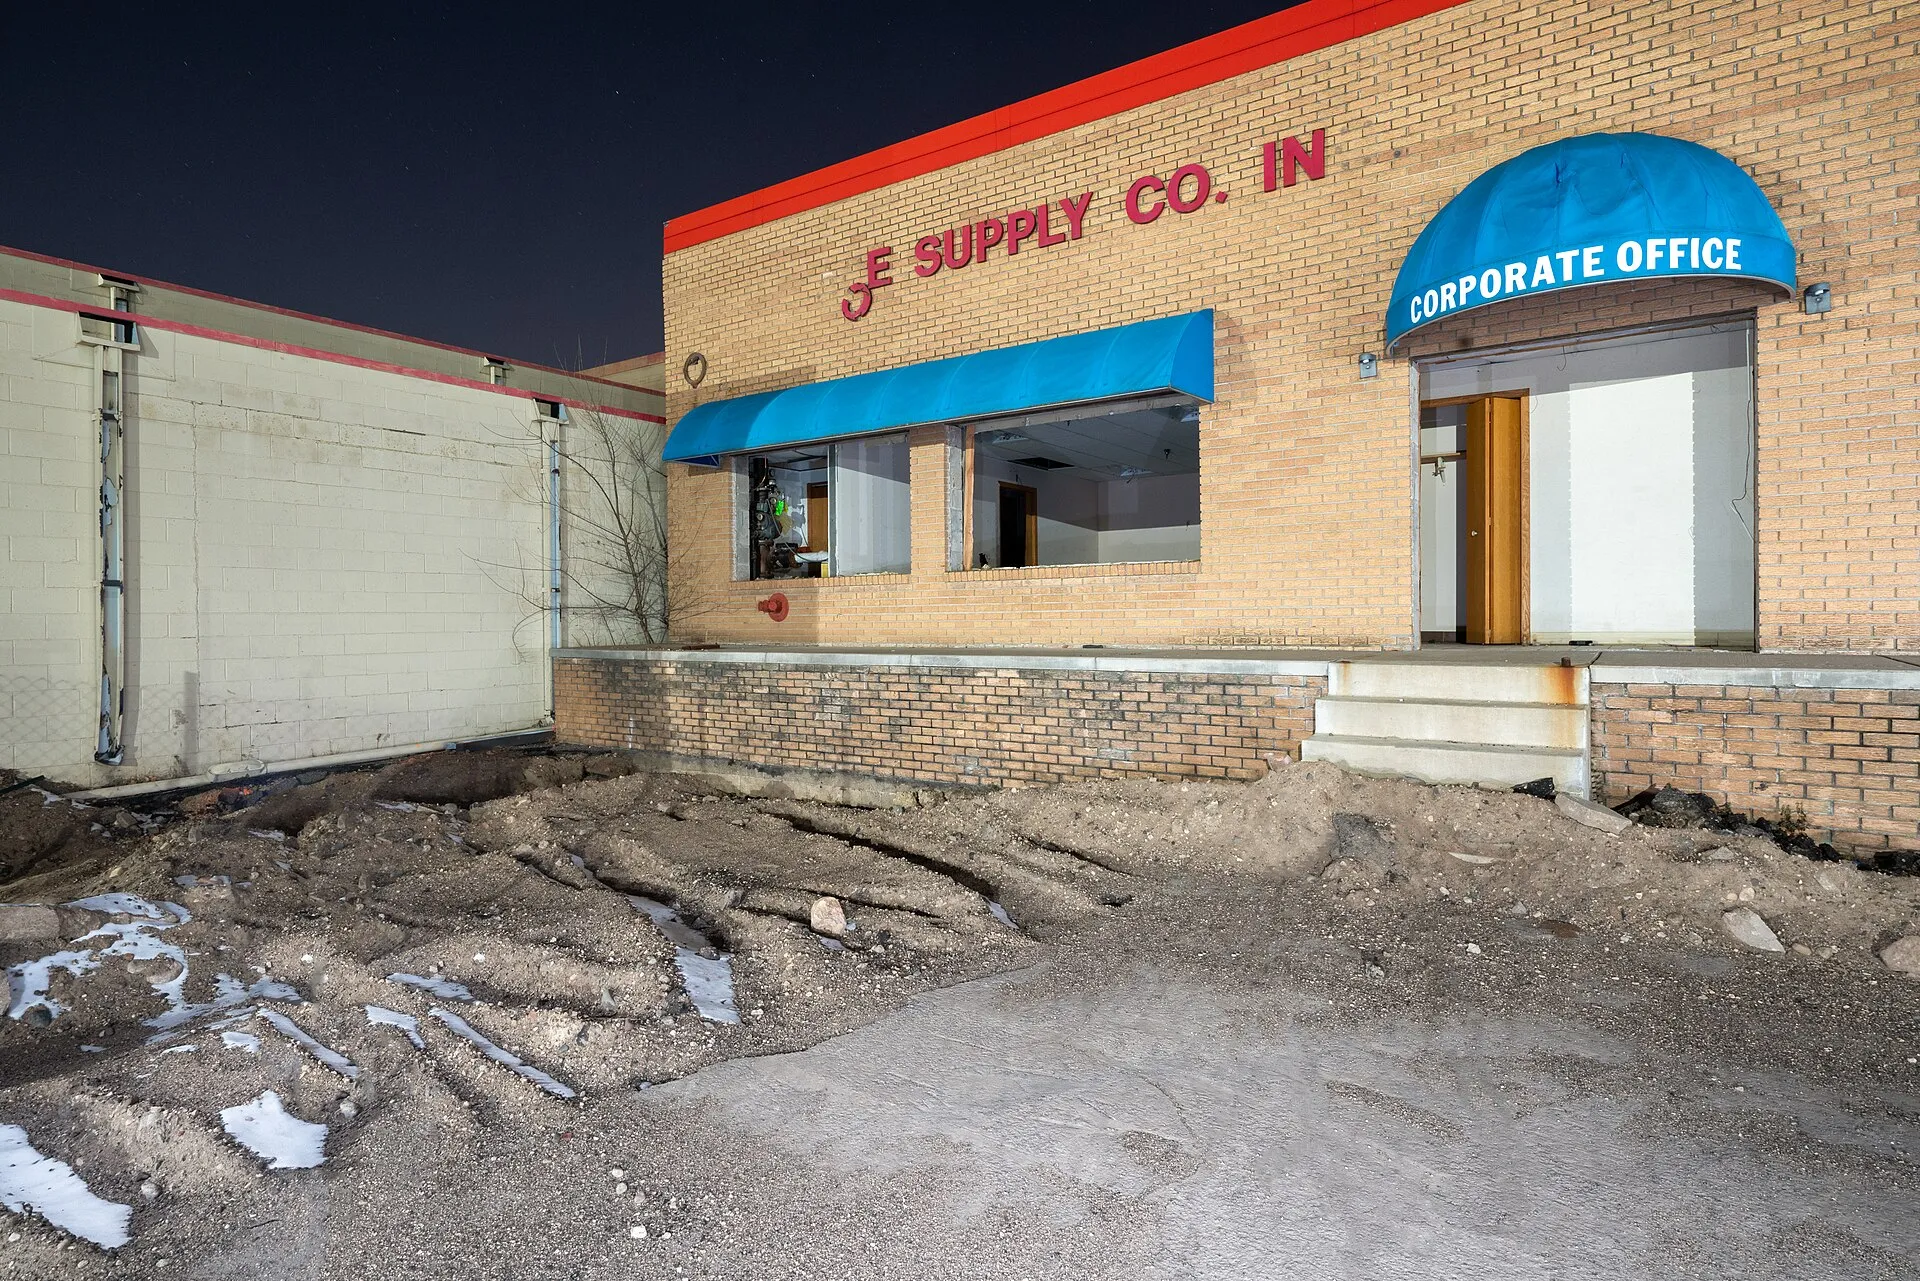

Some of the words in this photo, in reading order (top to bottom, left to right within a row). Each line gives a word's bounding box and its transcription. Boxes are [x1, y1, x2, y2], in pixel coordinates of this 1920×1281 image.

[914, 191, 1093, 278] SUPPLY
[1125, 163, 1228, 225] CO.
[1262, 128, 1326, 193] IN
[1410, 245, 1605, 324] CORPORATE
[1616, 237, 1742, 273] OFFICE
